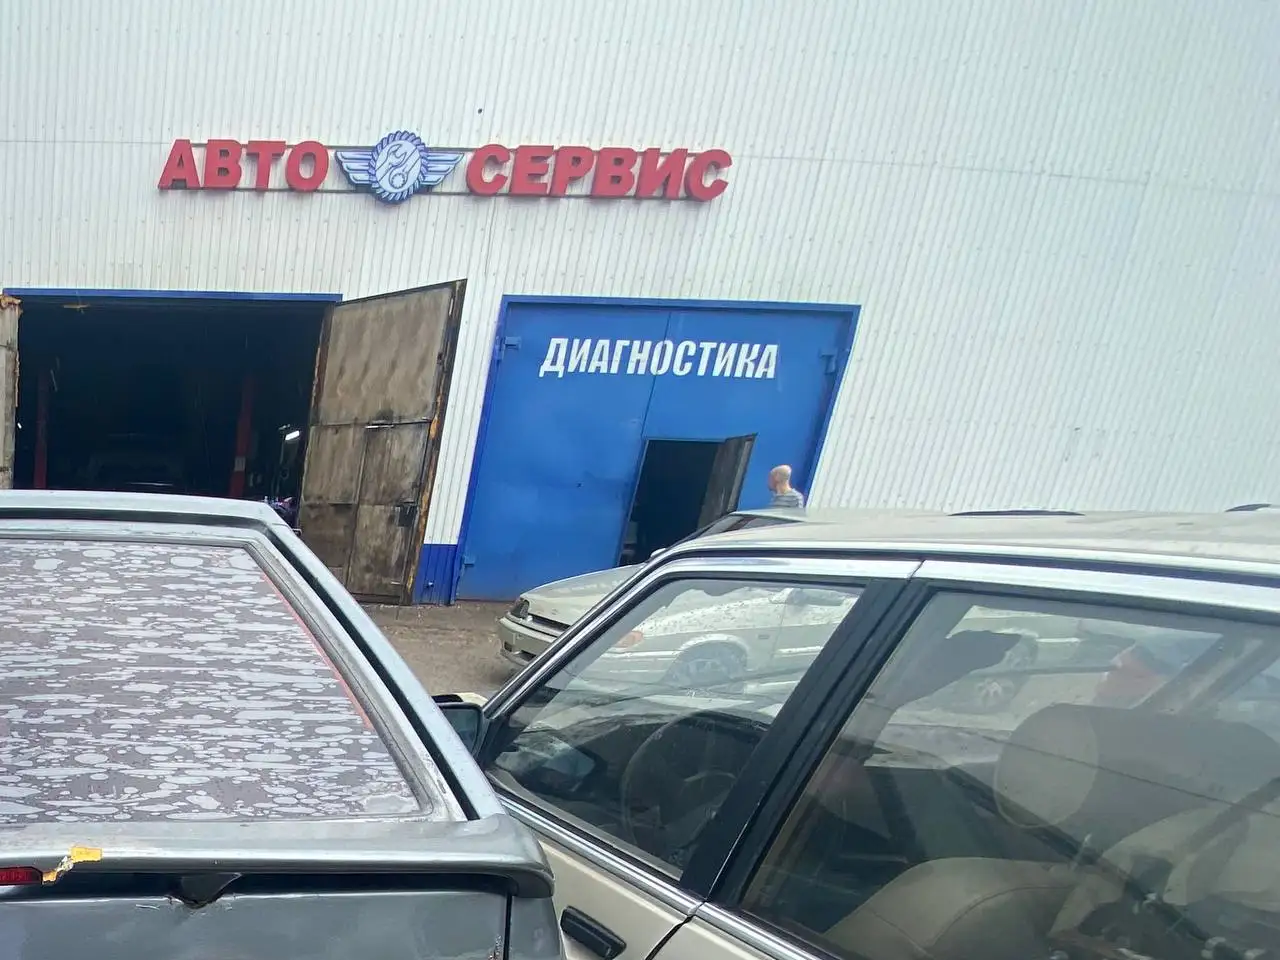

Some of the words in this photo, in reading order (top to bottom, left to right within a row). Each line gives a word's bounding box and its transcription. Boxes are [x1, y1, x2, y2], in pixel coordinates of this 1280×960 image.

[158, 139, 330, 192] АВТО
[466, 143, 733, 201] СЕРВИС
[538, 338, 778, 379] ДИАГНОСТИКА
